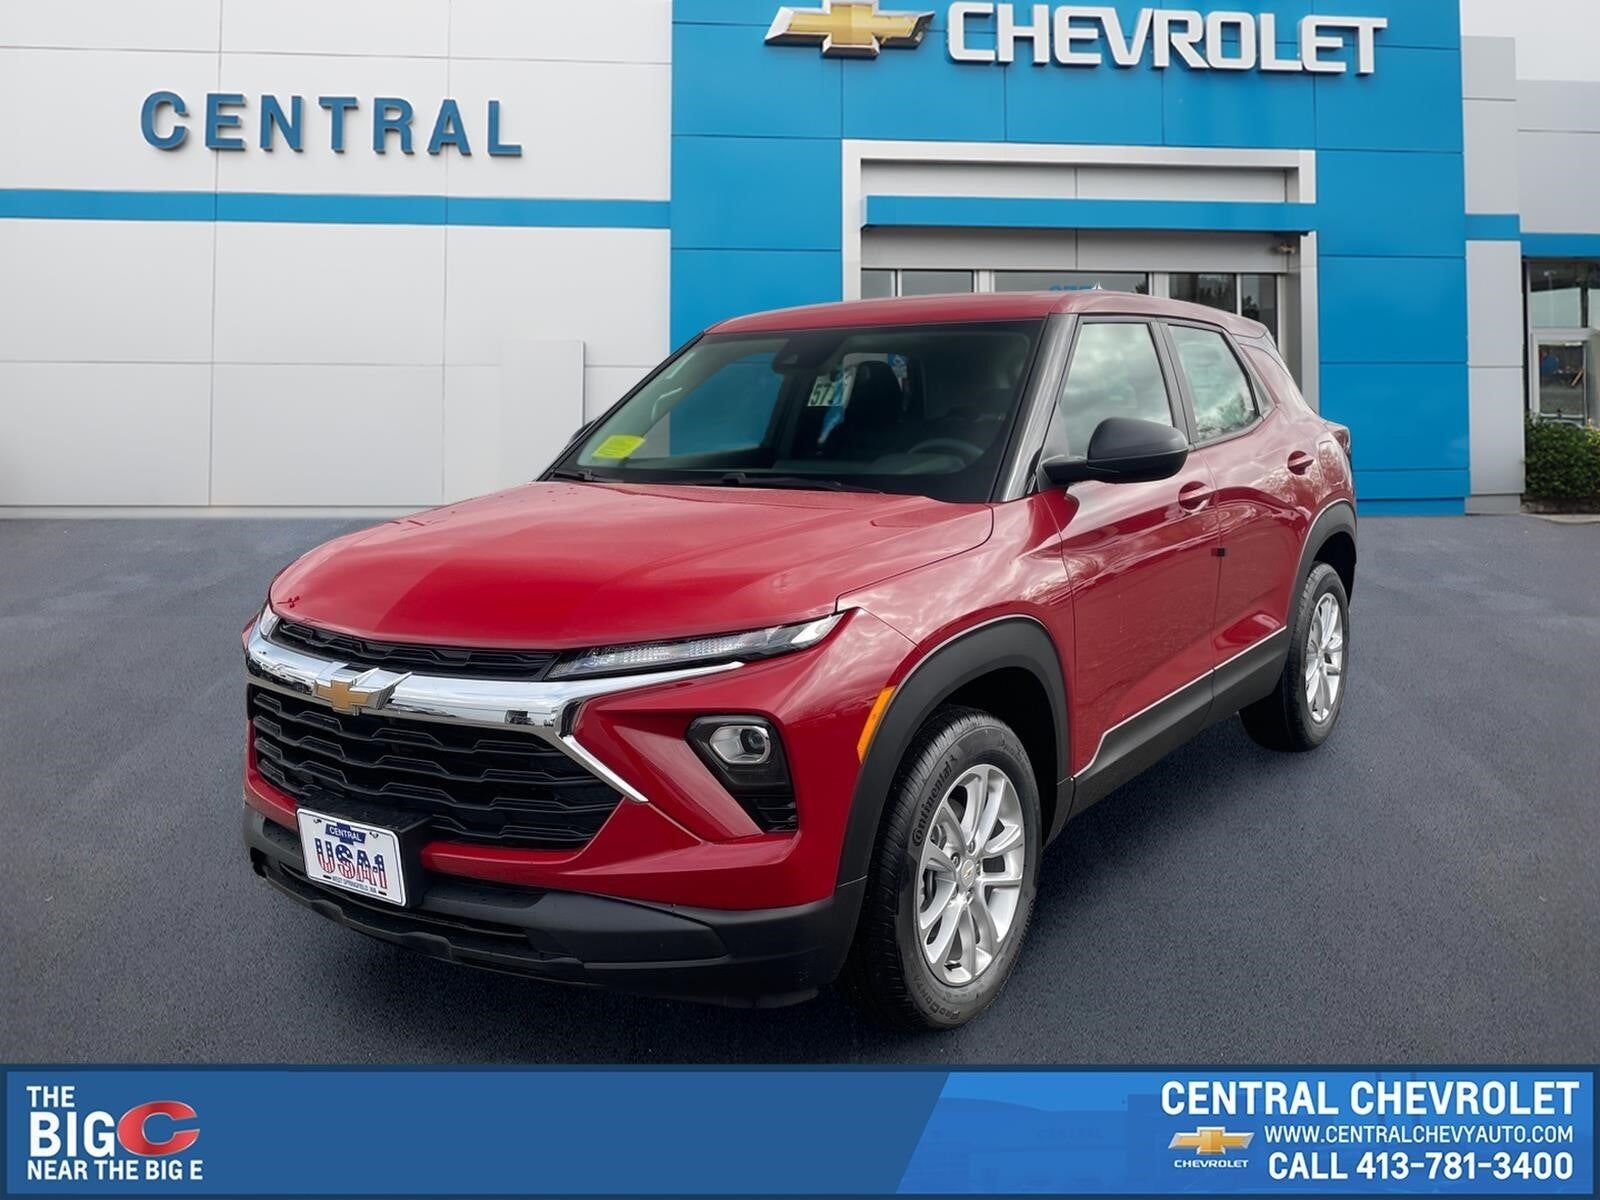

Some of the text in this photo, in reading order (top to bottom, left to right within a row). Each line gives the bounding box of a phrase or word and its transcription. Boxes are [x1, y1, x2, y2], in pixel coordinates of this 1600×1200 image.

[946, 2, 1388, 75] CHEVROLET
[140, 91, 523, 157] CENTRAL
[329, 826, 361, 841] CENTRAL
[911, 764, 952, 848] Continental
